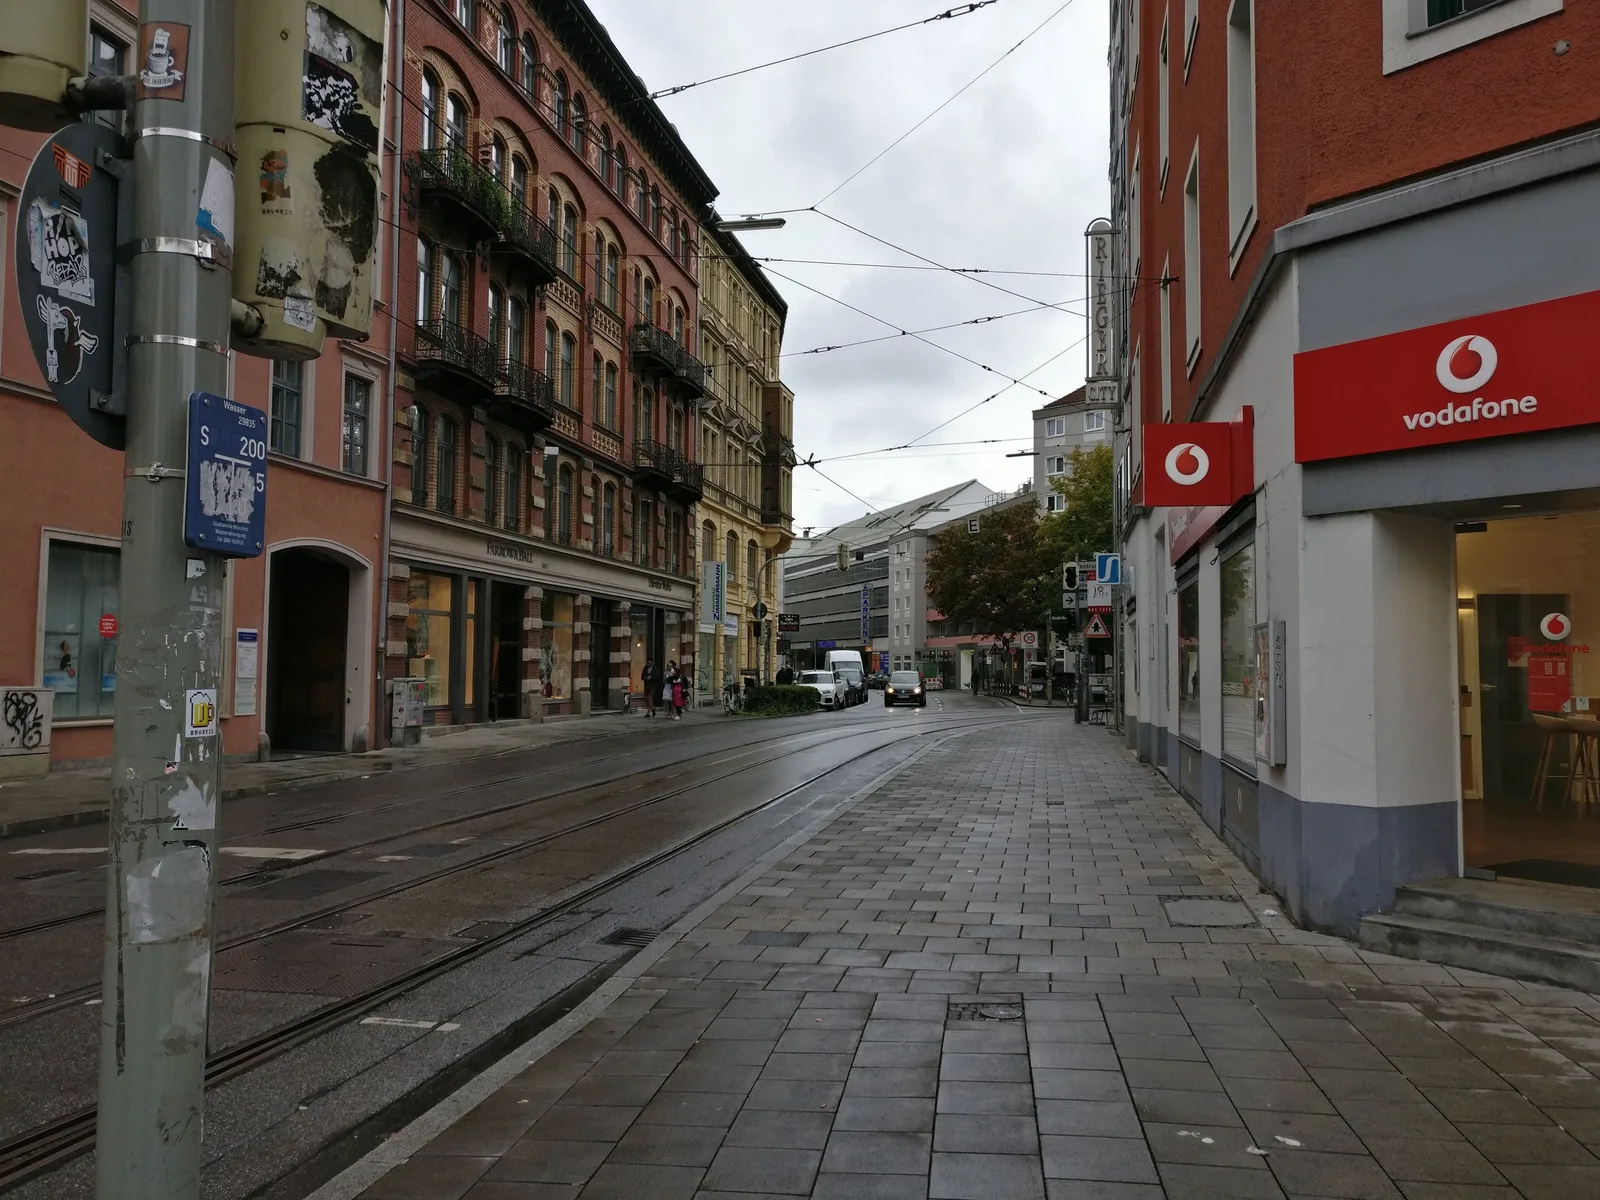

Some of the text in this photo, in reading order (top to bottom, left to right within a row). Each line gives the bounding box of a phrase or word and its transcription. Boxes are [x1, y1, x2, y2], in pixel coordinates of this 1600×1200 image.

[45, 236, 79, 260] HOP
[1094, 236, 1108, 375] RIEGER
[1088, 386, 1116, 402] CITY
[223, 400, 247, 415] Wasser
[1402, 395, 1537, 430] vodafone
[238, 416, 256, 429] 29835
[200, 425, 210, 446] S
[240, 436, 265, 460] 200
[969, 519, 978, 532] E
[1524, 642, 1590, 654] vodafone
